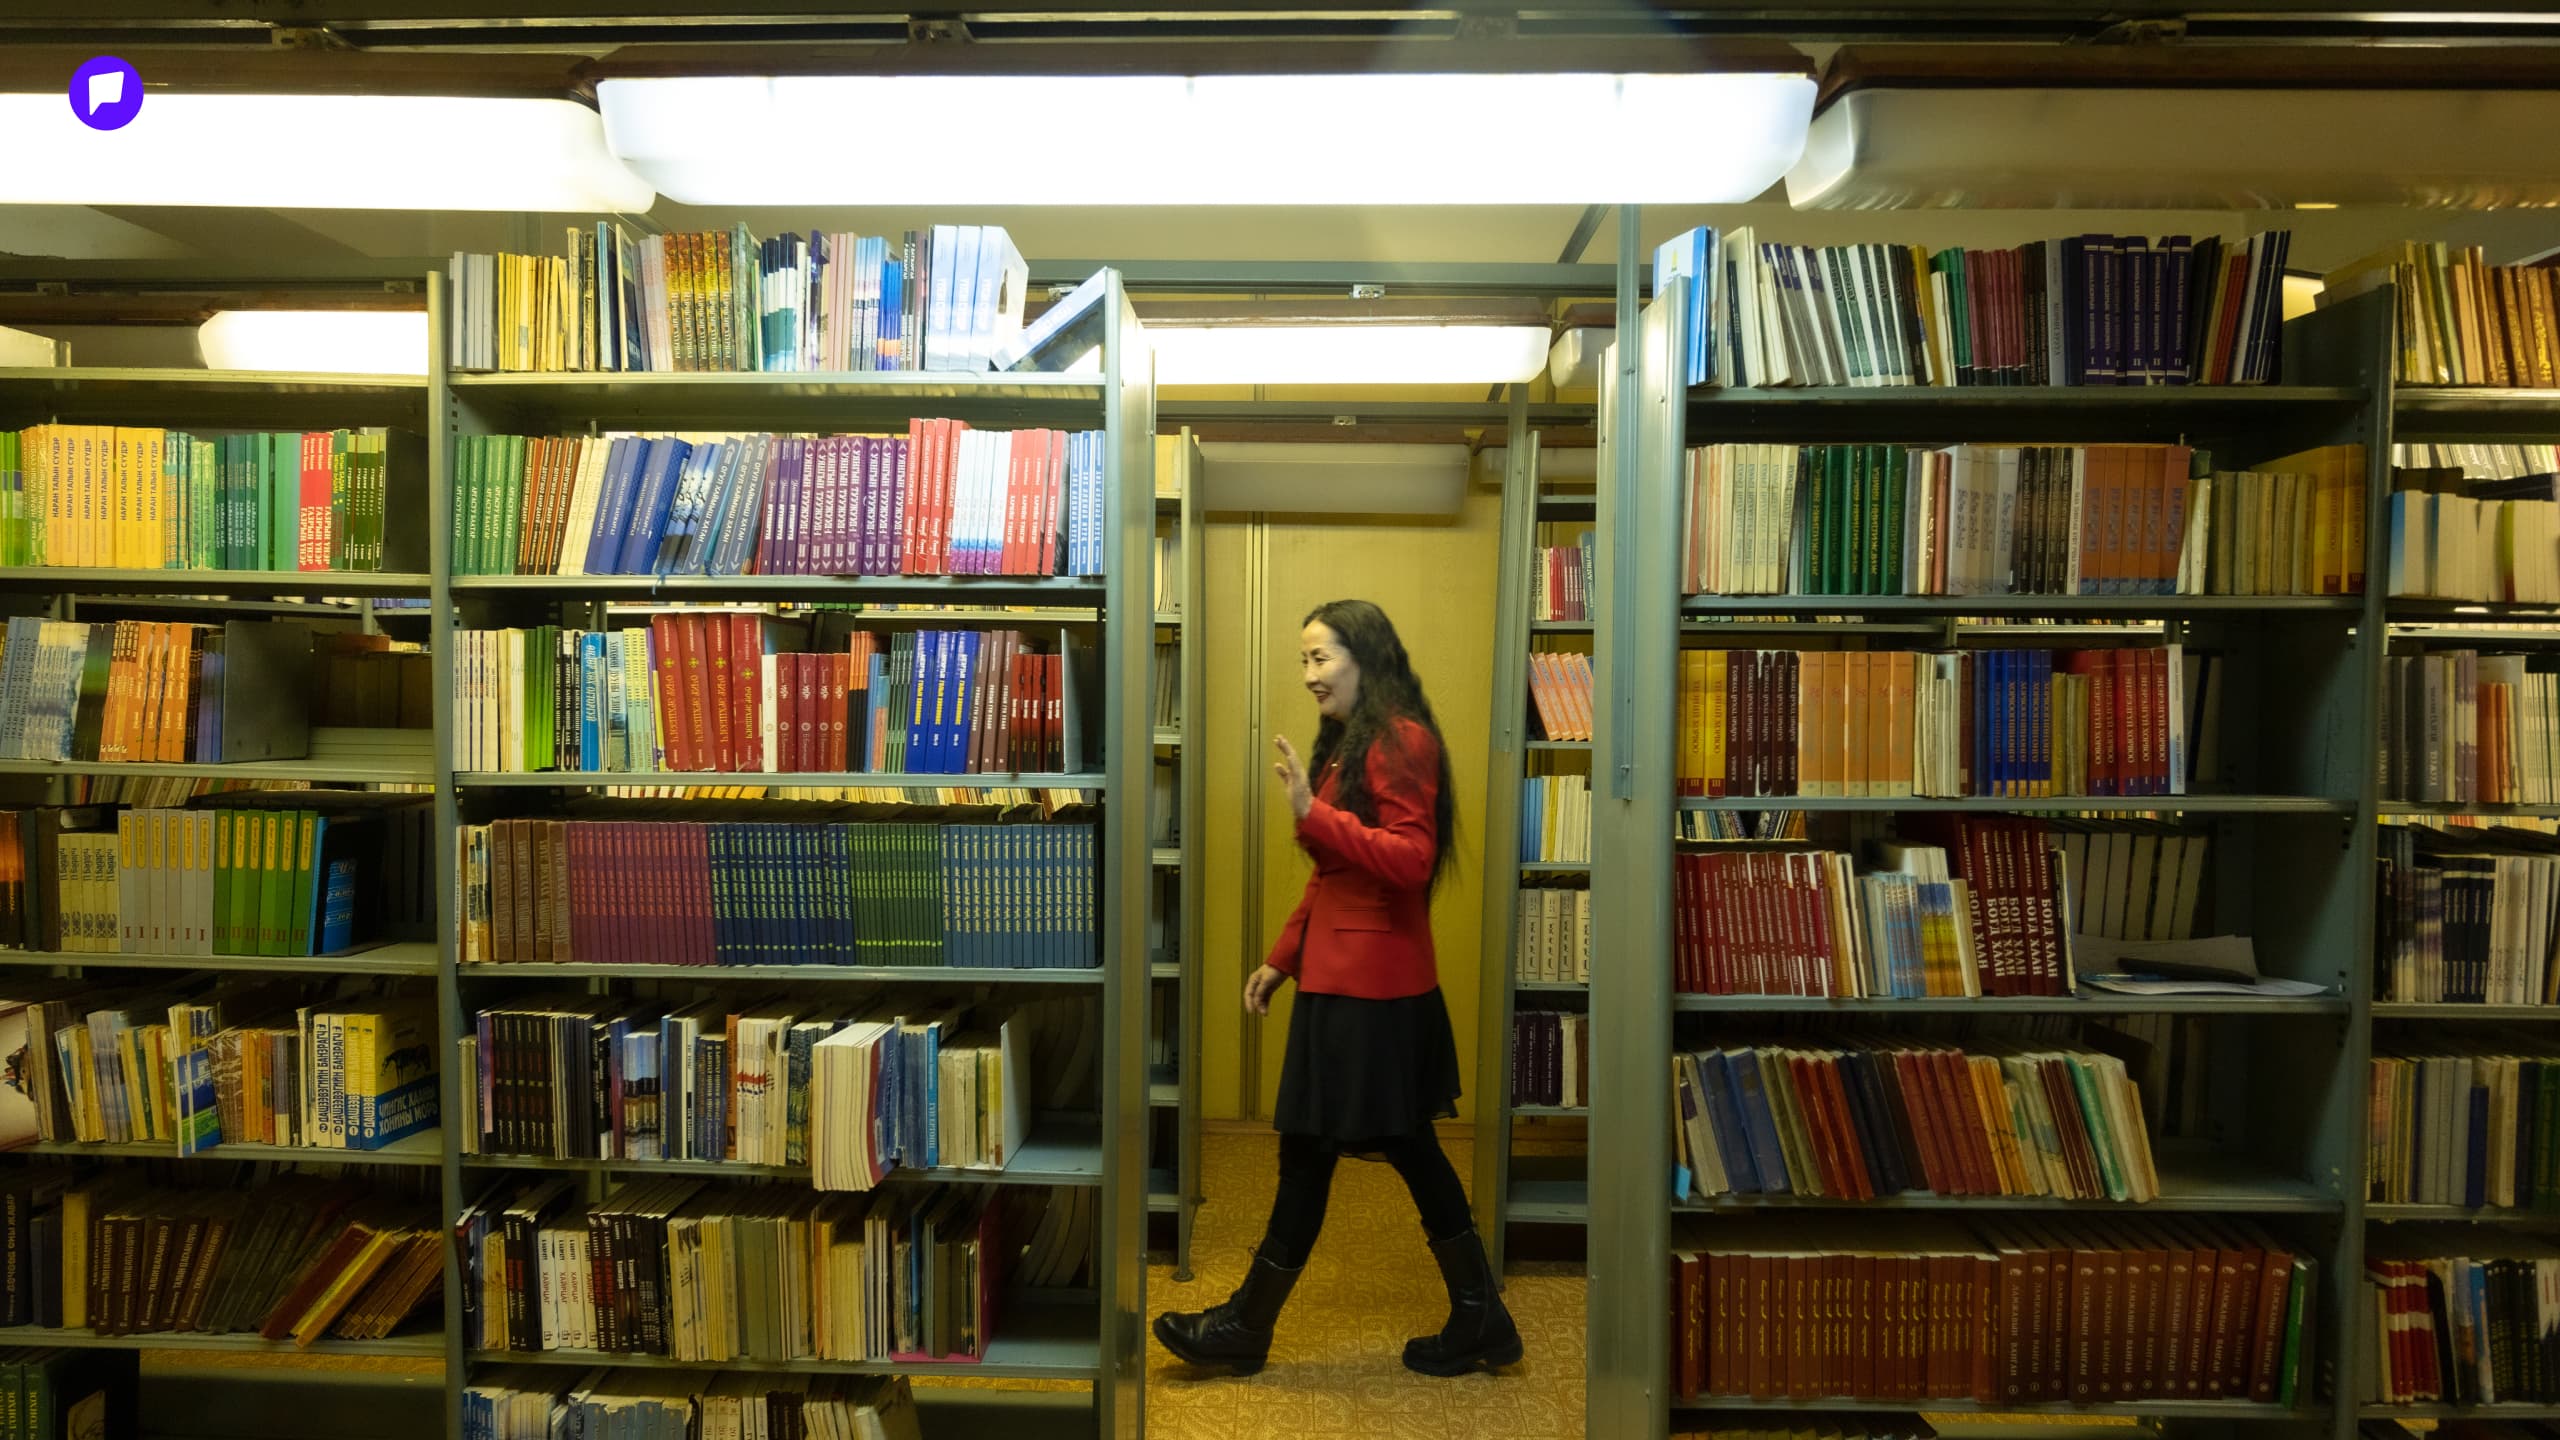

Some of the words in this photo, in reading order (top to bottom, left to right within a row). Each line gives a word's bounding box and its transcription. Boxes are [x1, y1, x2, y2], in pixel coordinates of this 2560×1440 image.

[315, 506, 323, 540] ГАЗРЫН
[323, 506, 332, 539] ГАЗРЫН
[698, 519, 711, 542] ХАТАН
[722, 520, 735, 543] ХАТАН
[737, 517, 749, 541] ХАТАН
[1968, 890, 1982, 928] БОГД
[1987, 898, 2000, 936] БОГД
[1998, 896, 2011, 934] БОГД
[2009, 896, 2022, 934] БОГД
[2026, 896, 2039, 934] БОГД
[2041, 898, 2054, 936] БОГД
[1974, 932, 1989, 969] ХААН
[1991, 940, 2005, 977] ХААН
[2003, 939, 2016, 976] ХААН
[2013, 939, 2027, 976] ХААН
[2030, 939, 2043, 975] ХААН
[2045, 941, 2058, 978] ХААН
